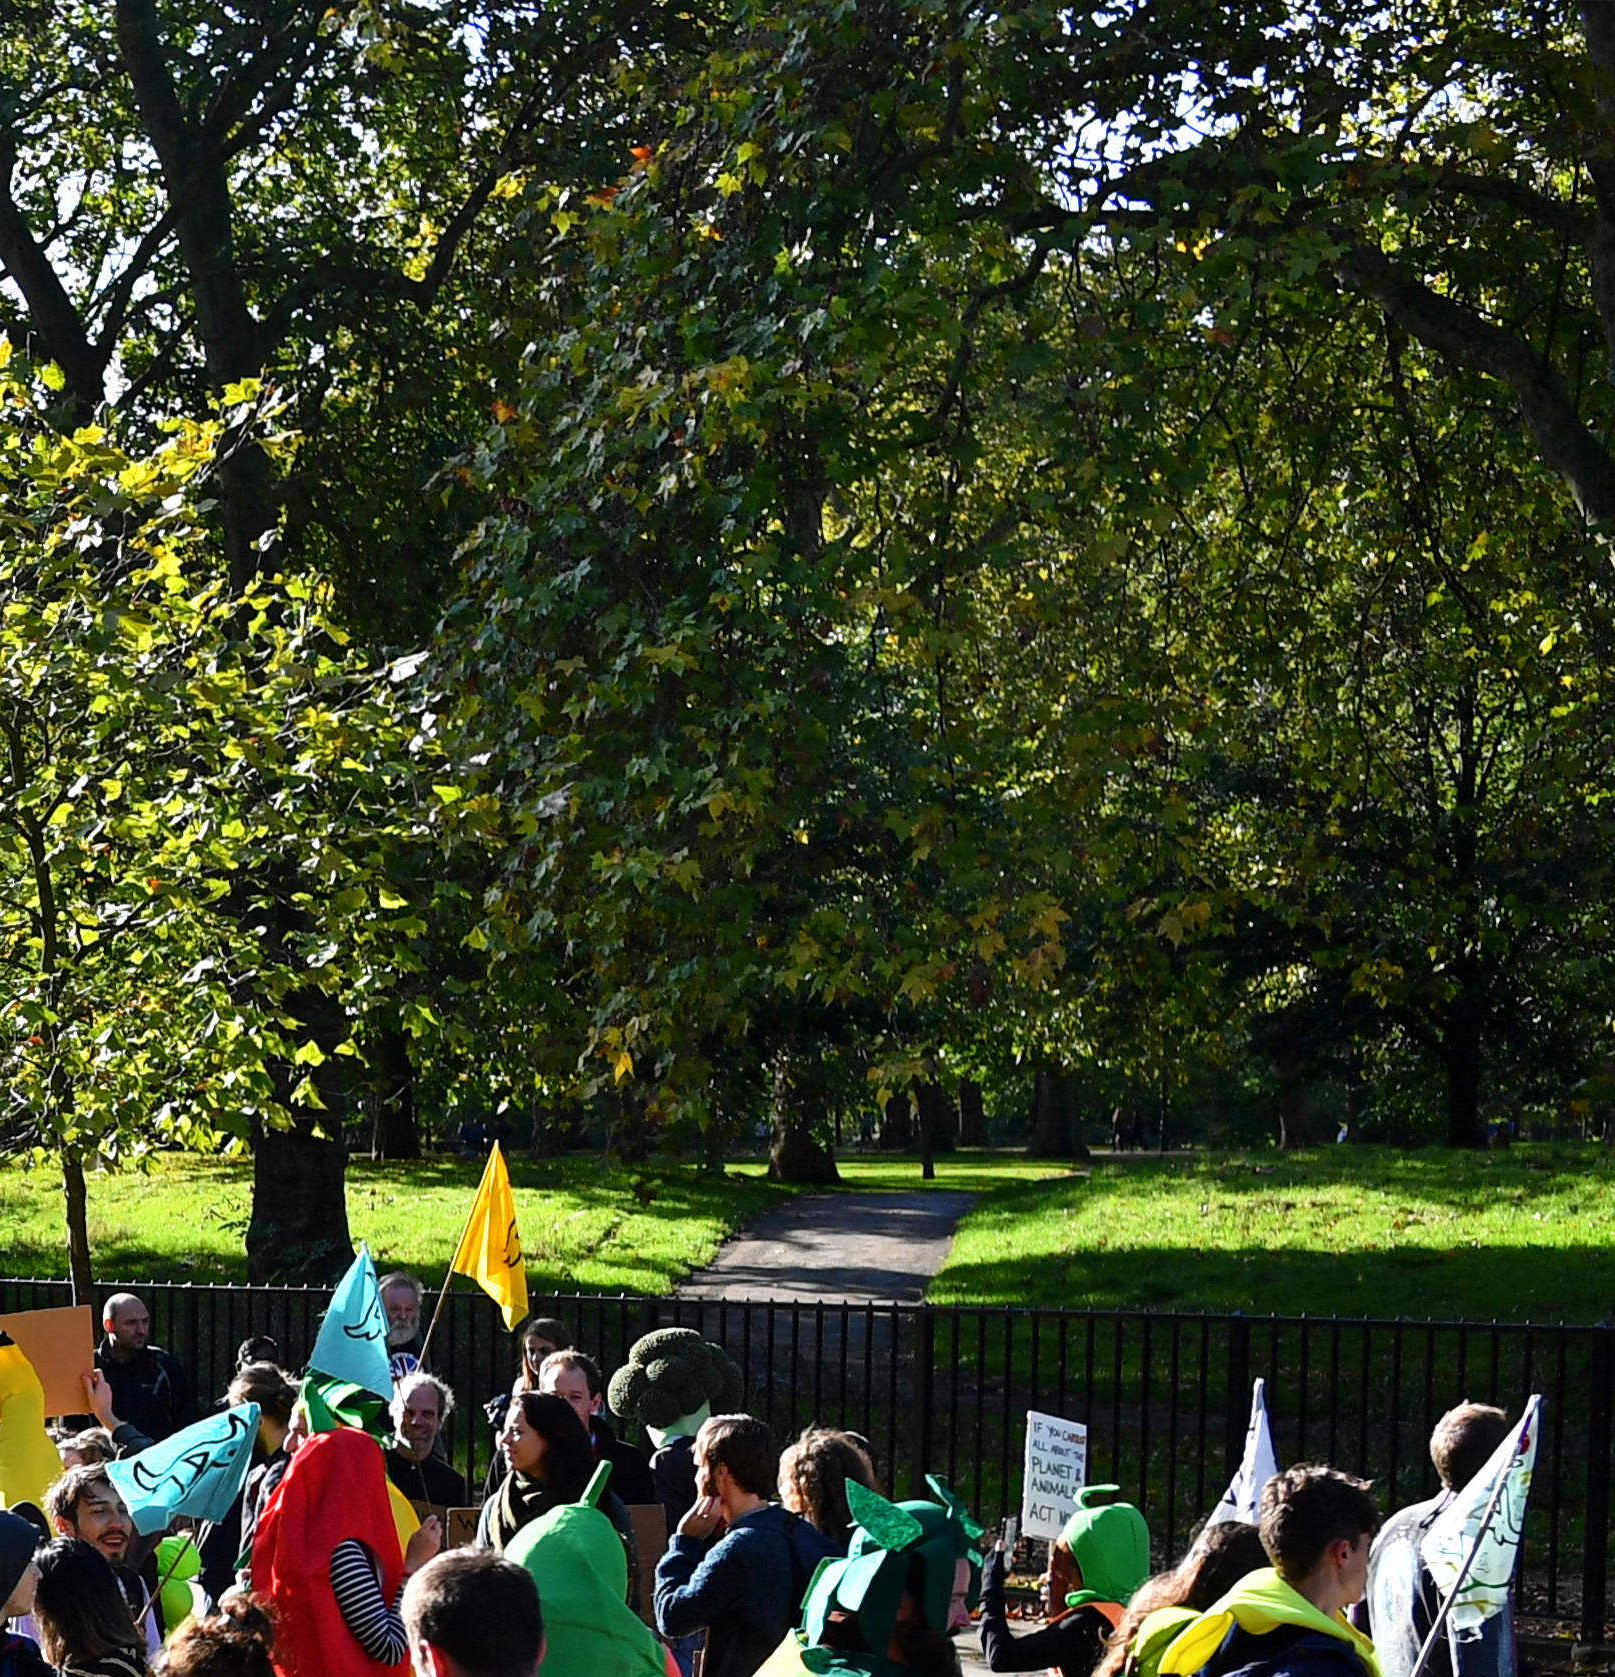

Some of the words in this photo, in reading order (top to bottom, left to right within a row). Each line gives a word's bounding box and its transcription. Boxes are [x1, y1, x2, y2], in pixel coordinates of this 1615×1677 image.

[1034, 1421, 1044, 1433] IF
[1046, 1425, 1061, 1438] YOU
[1032, 1438, 1048, 1452] ALL
[1050, 1444, 1072, 1457] ABOUT
[1032, 1456, 1072, 1479] PLANET
[1031, 1478, 1077, 1500] ANIMALS
[1029, 1502, 1055, 1523] ACT
[1059, 1510, 1071, 1526] NO
